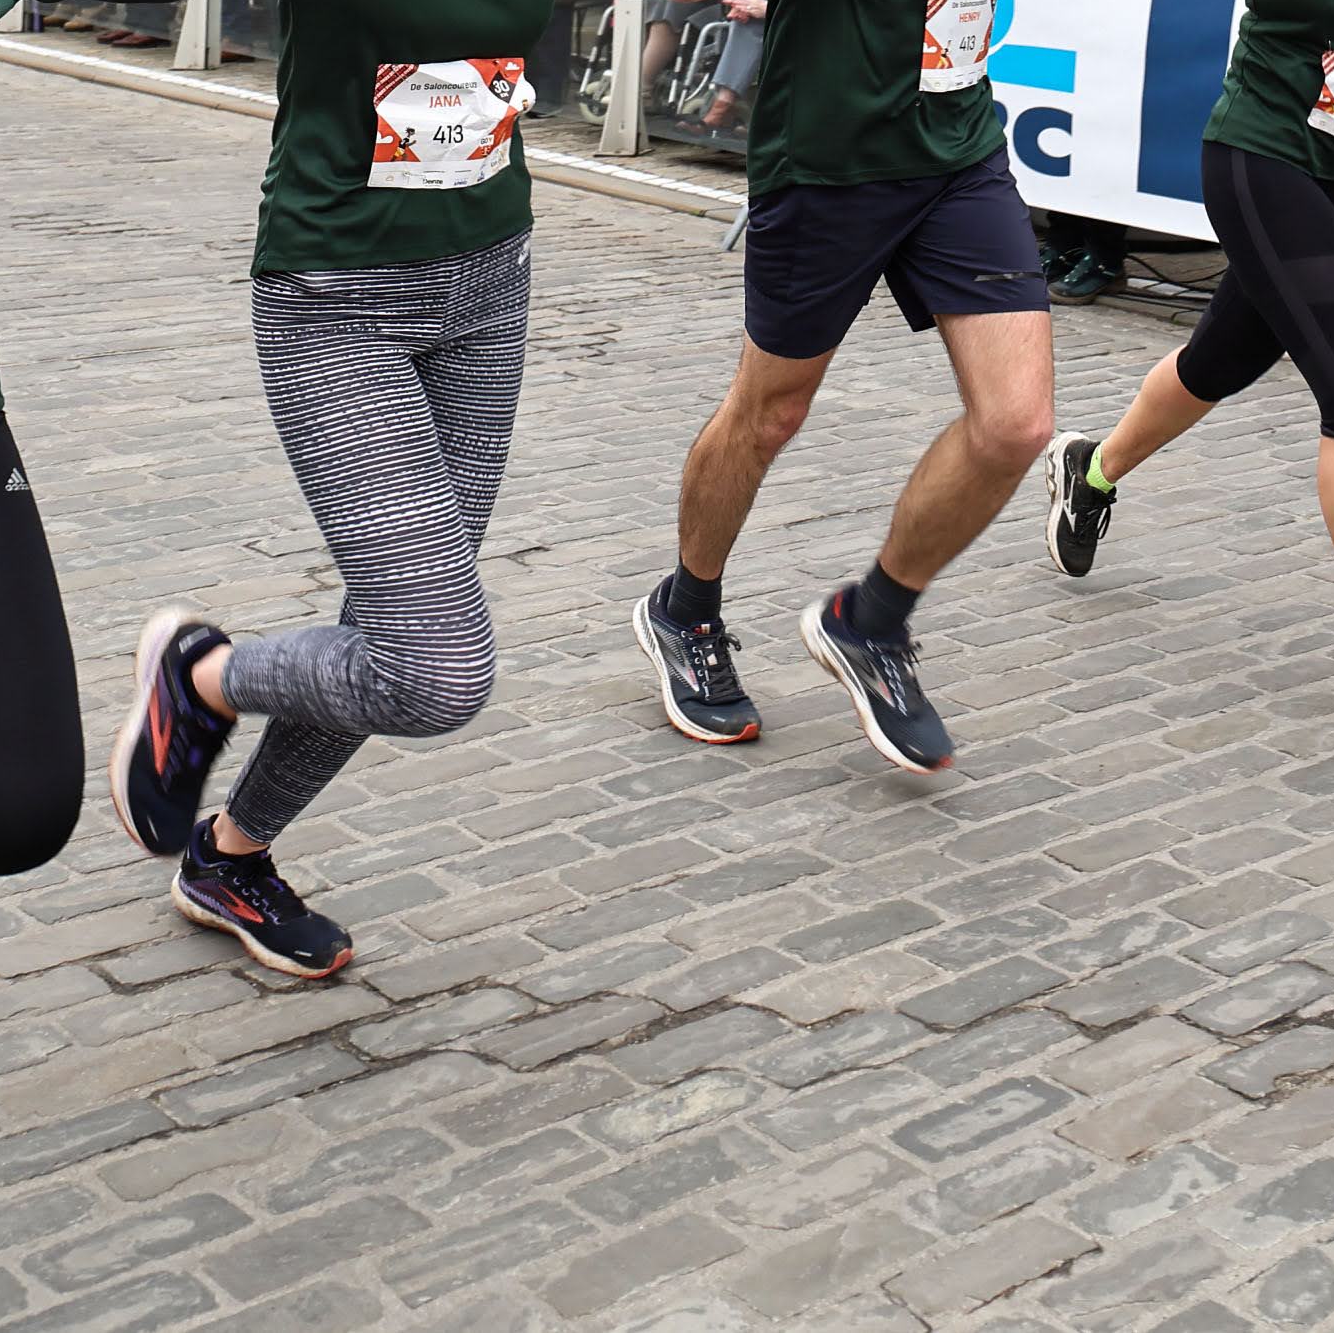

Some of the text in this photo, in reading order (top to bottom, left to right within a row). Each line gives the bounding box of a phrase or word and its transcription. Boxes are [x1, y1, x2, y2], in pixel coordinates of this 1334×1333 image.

[959, 35, 976, 52] 413
[410, 83, 422, 91] De
[492, 80, 511, 94] 30
[429, 94, 463, 109] JANA
[433, 124, 464, 145] 413
